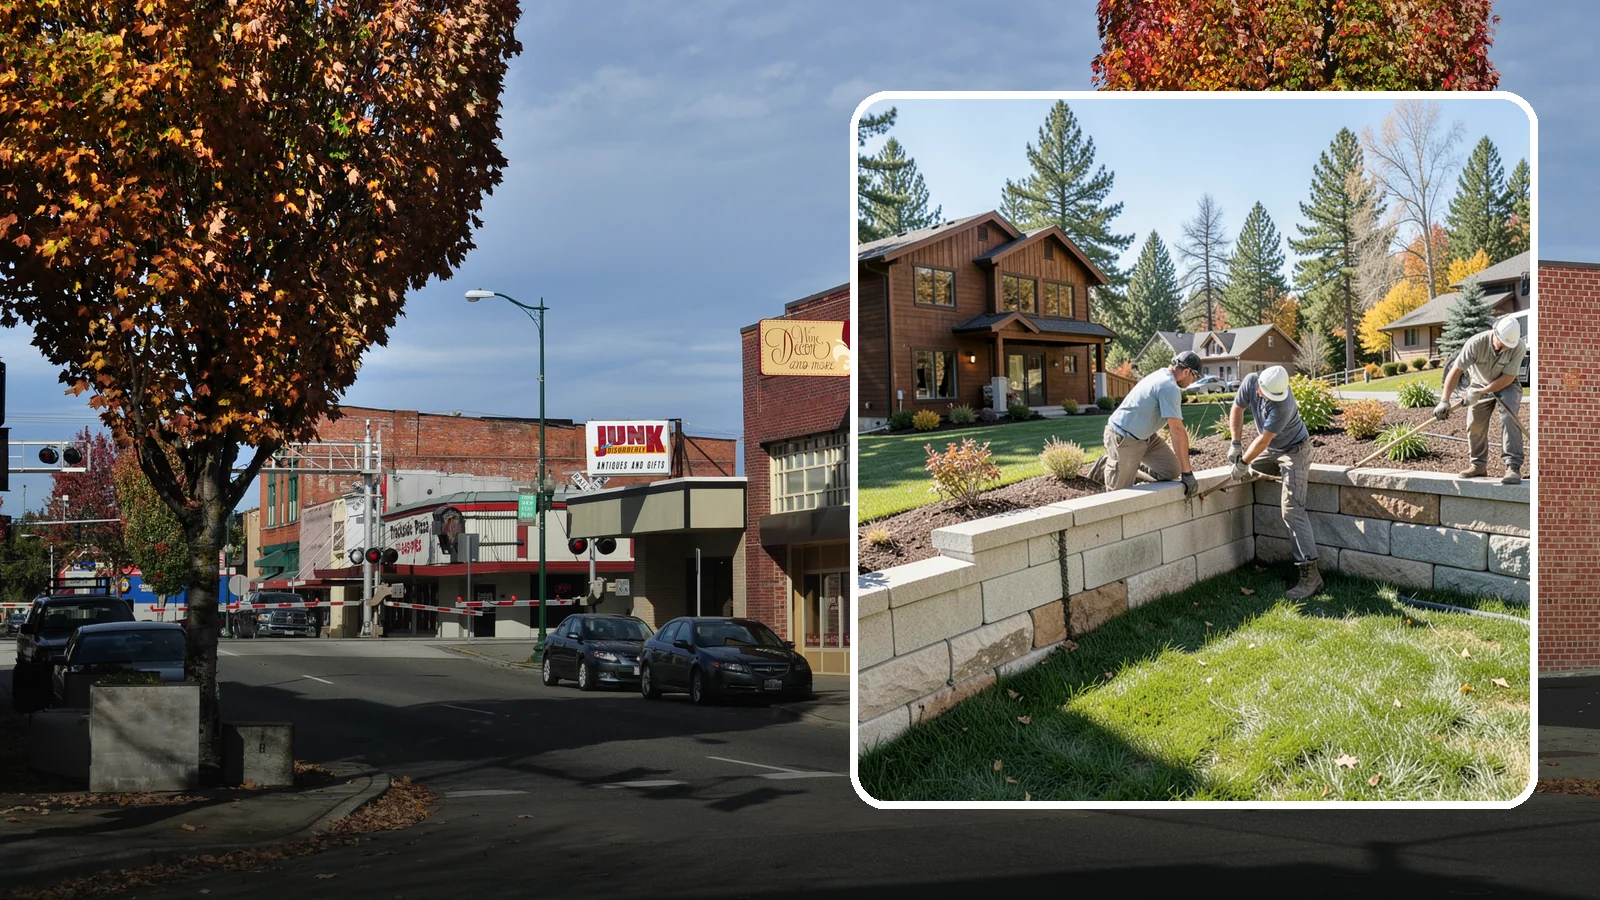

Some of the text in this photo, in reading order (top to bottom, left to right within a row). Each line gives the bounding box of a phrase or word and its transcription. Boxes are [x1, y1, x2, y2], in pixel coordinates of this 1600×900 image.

[595, 425, 664, 457] JUNK
[607, 446, 646, 454] DISORDERLY
[597, 460, 665, 470] ANTIQUES AND GIFTS
[352, 498, 365, 511] CRO
[390, 519, 429, 540] Trackside Pizza
